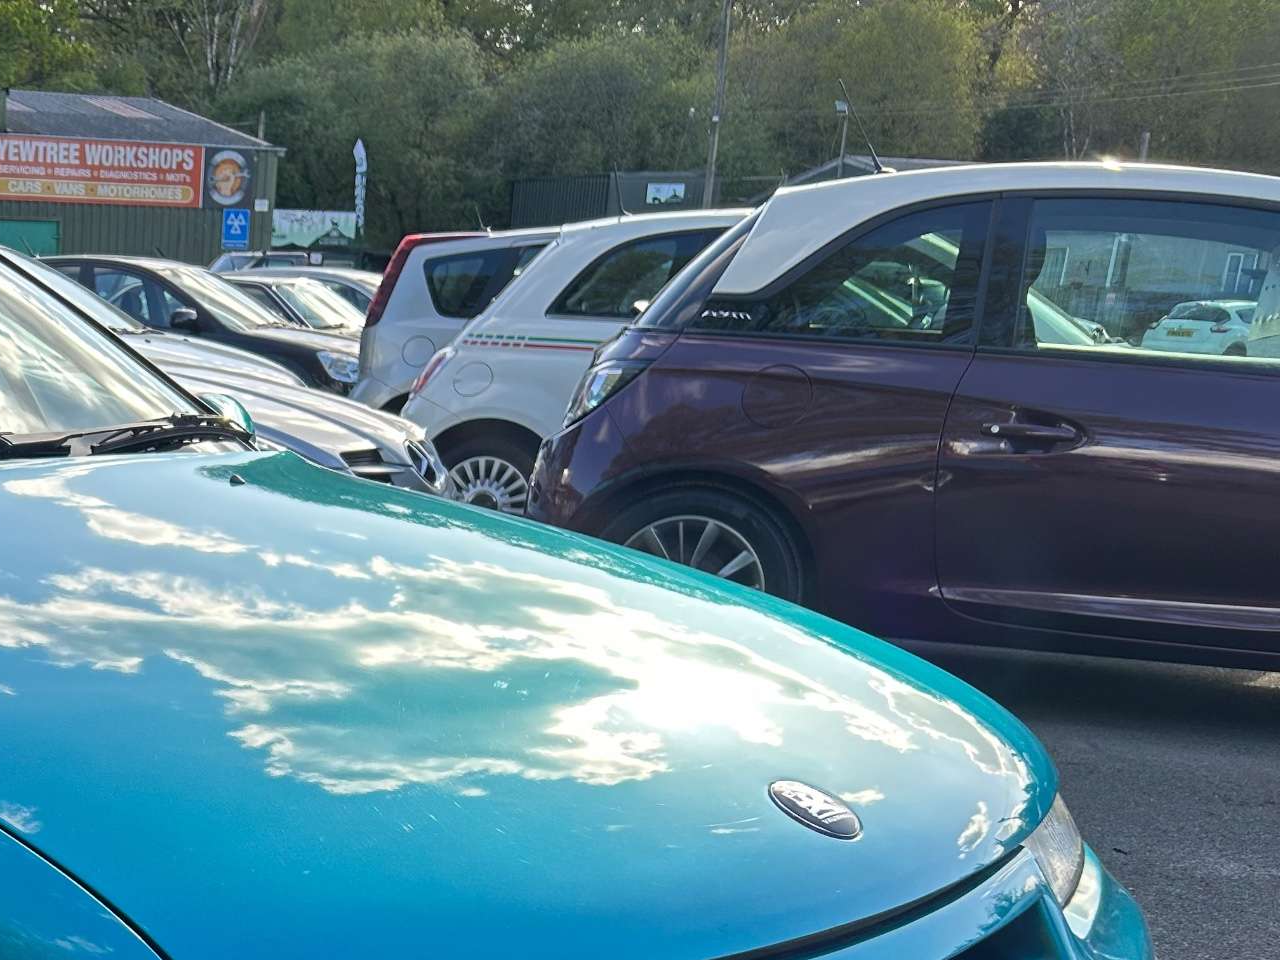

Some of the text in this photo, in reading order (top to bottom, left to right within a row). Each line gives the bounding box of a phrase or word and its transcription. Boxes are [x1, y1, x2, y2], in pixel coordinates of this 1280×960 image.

[85, 142, 195, 171] WORKSHOPS
[54, 167, 91, 178] REPAIRS
[100, 170, 157, 181] DIAGNOSTICS
[7, 180, 182, 200] CARS VANS MOTORHOMES
